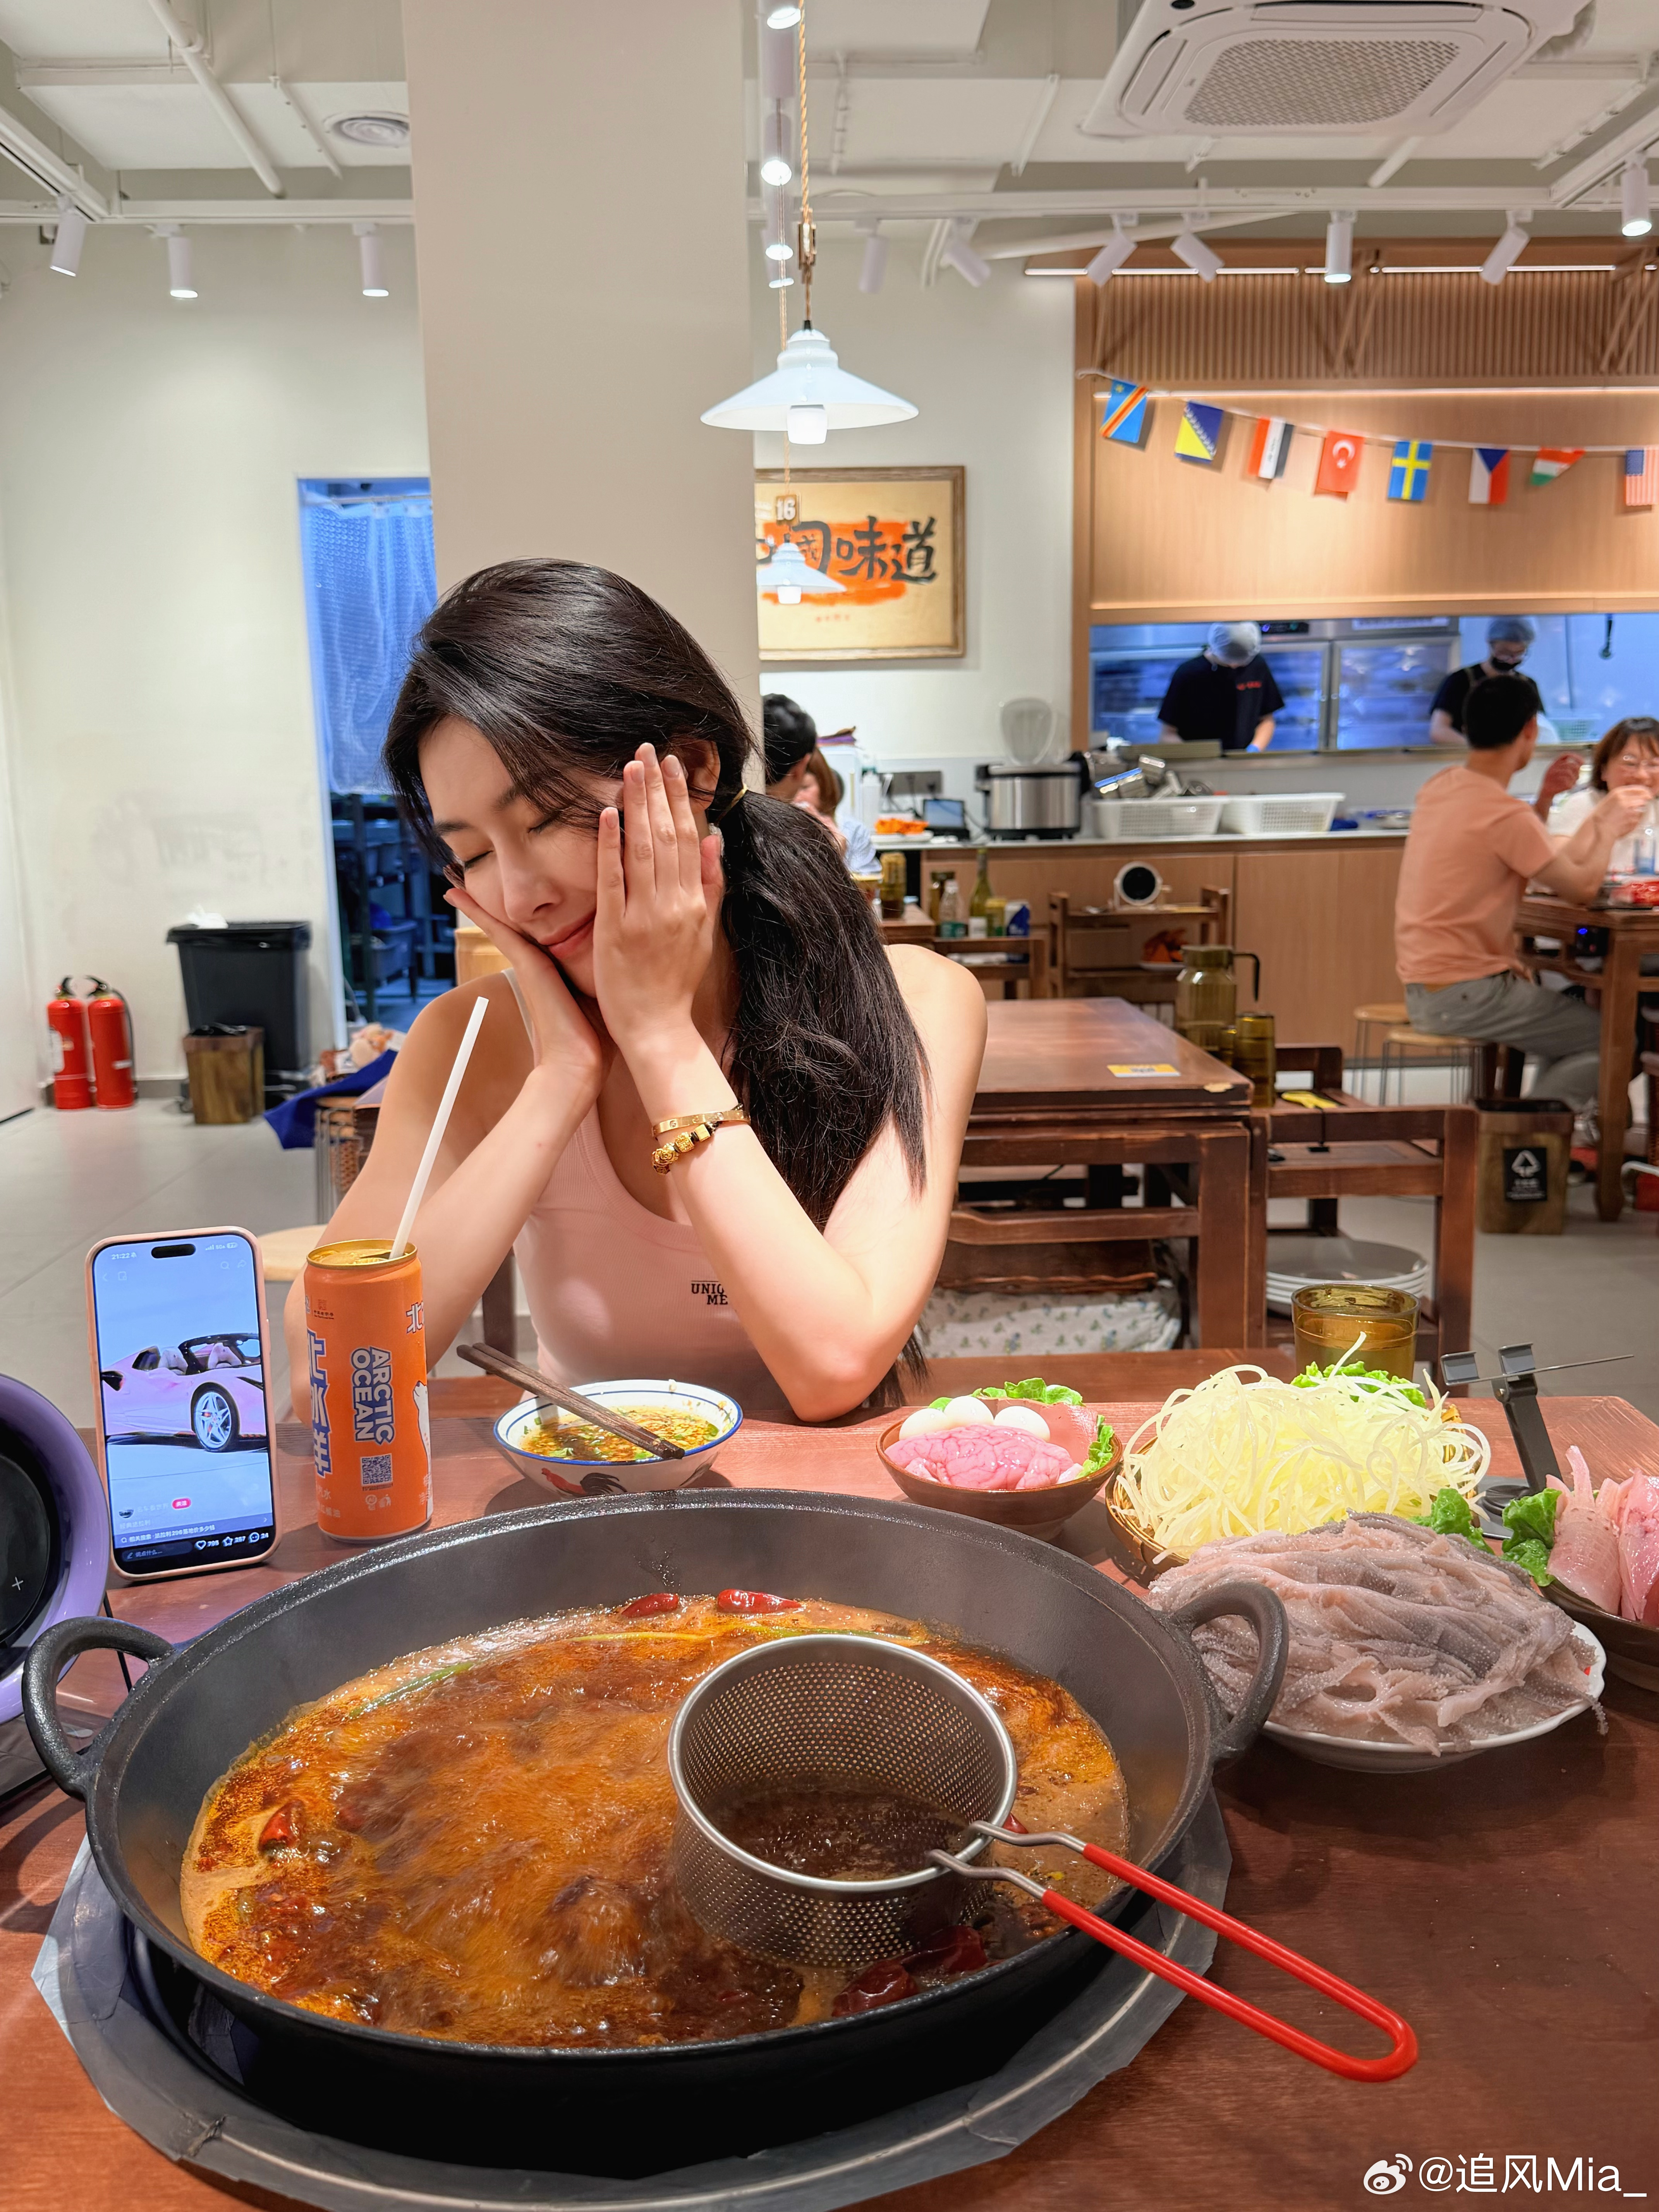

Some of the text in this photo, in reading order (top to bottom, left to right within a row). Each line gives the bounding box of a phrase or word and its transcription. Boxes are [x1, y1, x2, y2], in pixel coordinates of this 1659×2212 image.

[776, 497, 796, 520] 16
[111, 1252, 131, 1260] 21:22
[351, 1348, 375, 1442] OCEAN
[370, 1346, 395, 1446] ARCTIC
